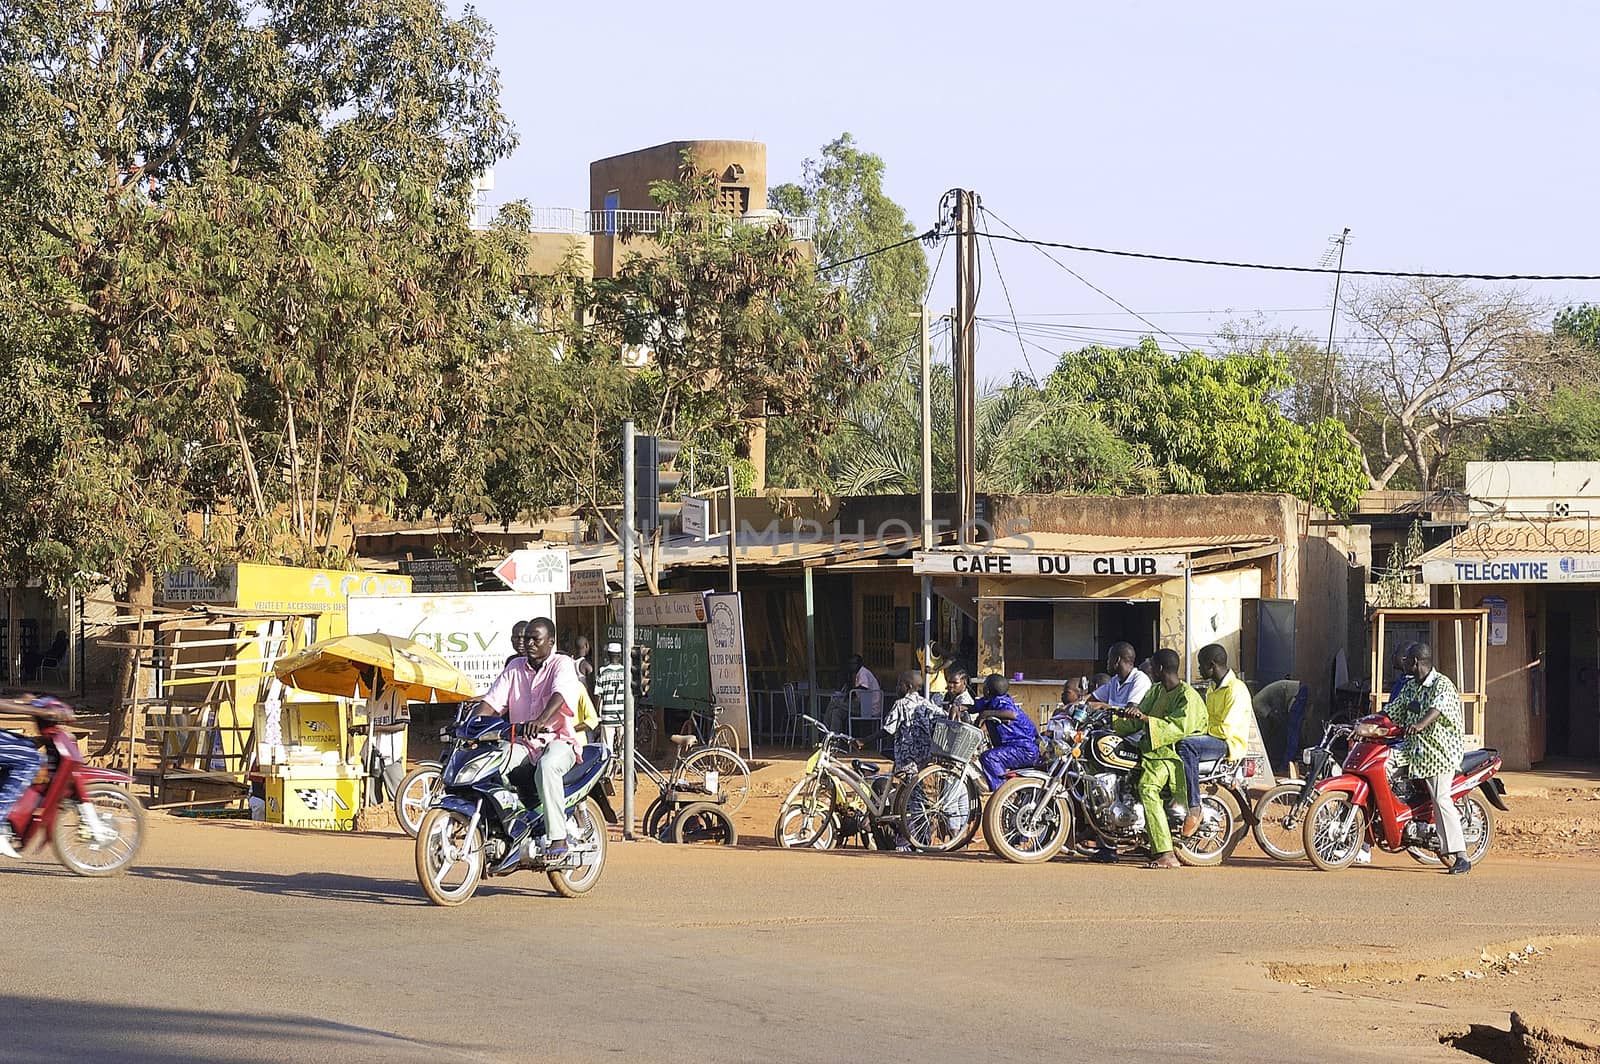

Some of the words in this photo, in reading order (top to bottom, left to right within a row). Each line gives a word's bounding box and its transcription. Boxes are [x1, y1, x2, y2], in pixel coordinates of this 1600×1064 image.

[952, 555, 1012, 574] CAFE
[1037, 556, 1071, 575] DU
[1092, 557, 1157, 575] CLUB
